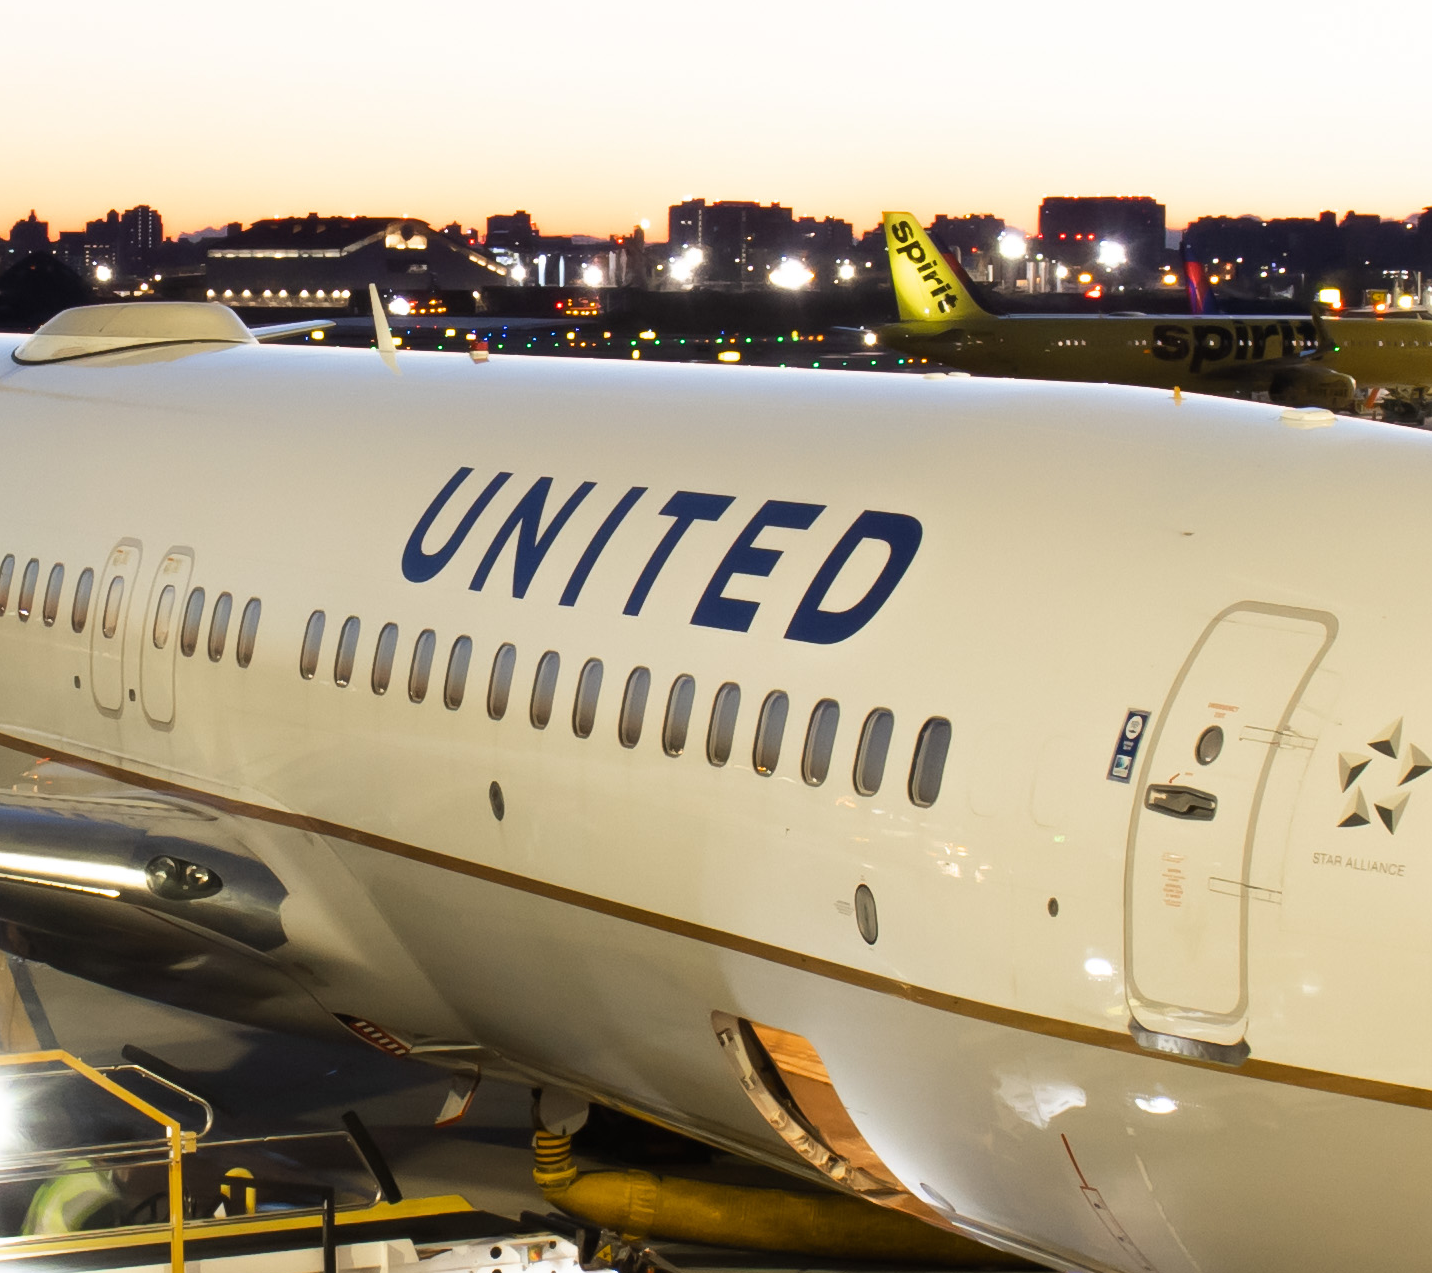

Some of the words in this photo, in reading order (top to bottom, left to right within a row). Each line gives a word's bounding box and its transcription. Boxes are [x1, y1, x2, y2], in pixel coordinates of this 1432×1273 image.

[891, 220, 958, 314] spirit
[401, 466, 923, 645] UNITED
[1312, 852, 1342, 867] STAR
[1345, 856, 1406, 877] ALLIANCE
